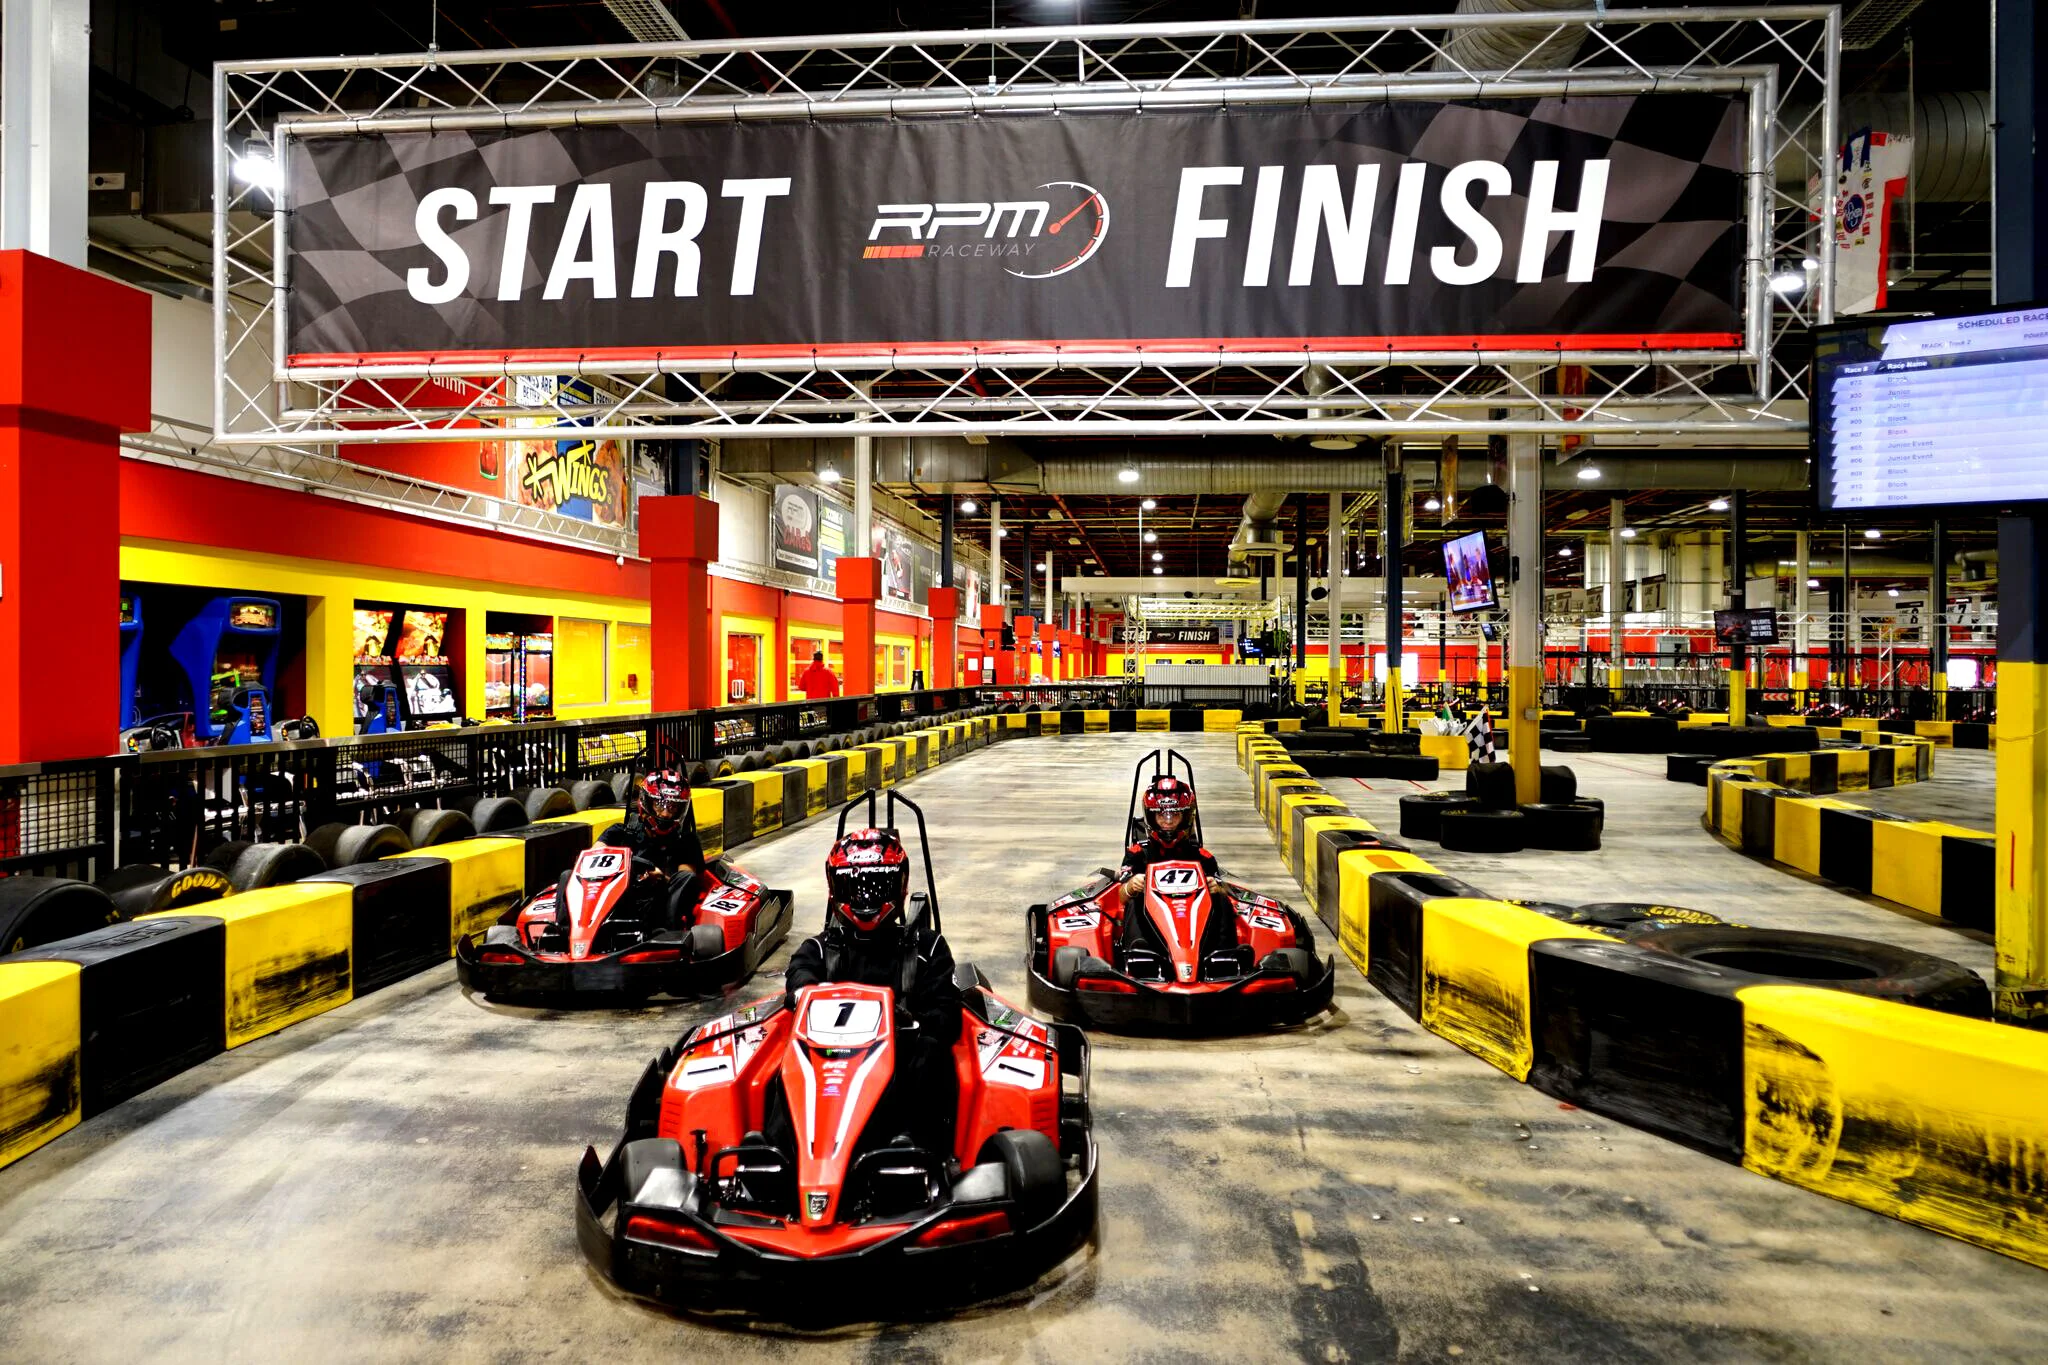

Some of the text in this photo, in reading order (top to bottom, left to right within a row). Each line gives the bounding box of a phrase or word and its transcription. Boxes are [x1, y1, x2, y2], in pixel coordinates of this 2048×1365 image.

[868, 201, 1050, 240] RPM
[407, 159, 1611, 304] START FINISH
[927, 243, 1036, 258] RACEWAY
[1957, 315, 2020, 330] SCHEDULED
[1844, 366, 1861, 374] Race
[1887, 360, 1928, 370] Race Name
[1626, 588, 1634, 612] 2
[1655, 583, 1661, 608] 1
[1957, 604, 1967, 624] 7
[1178, 630, 1211, 641] FINISH
[589, 854, 616, 869] 18
[860, 865, 900, 874] RACEWAY
[1159, 869, 1195, 884] 47
[710, 900, 740, 911] 18
[833, 1002, 857, 1028] 1
[998, 1063, 1036, 1078] 1
